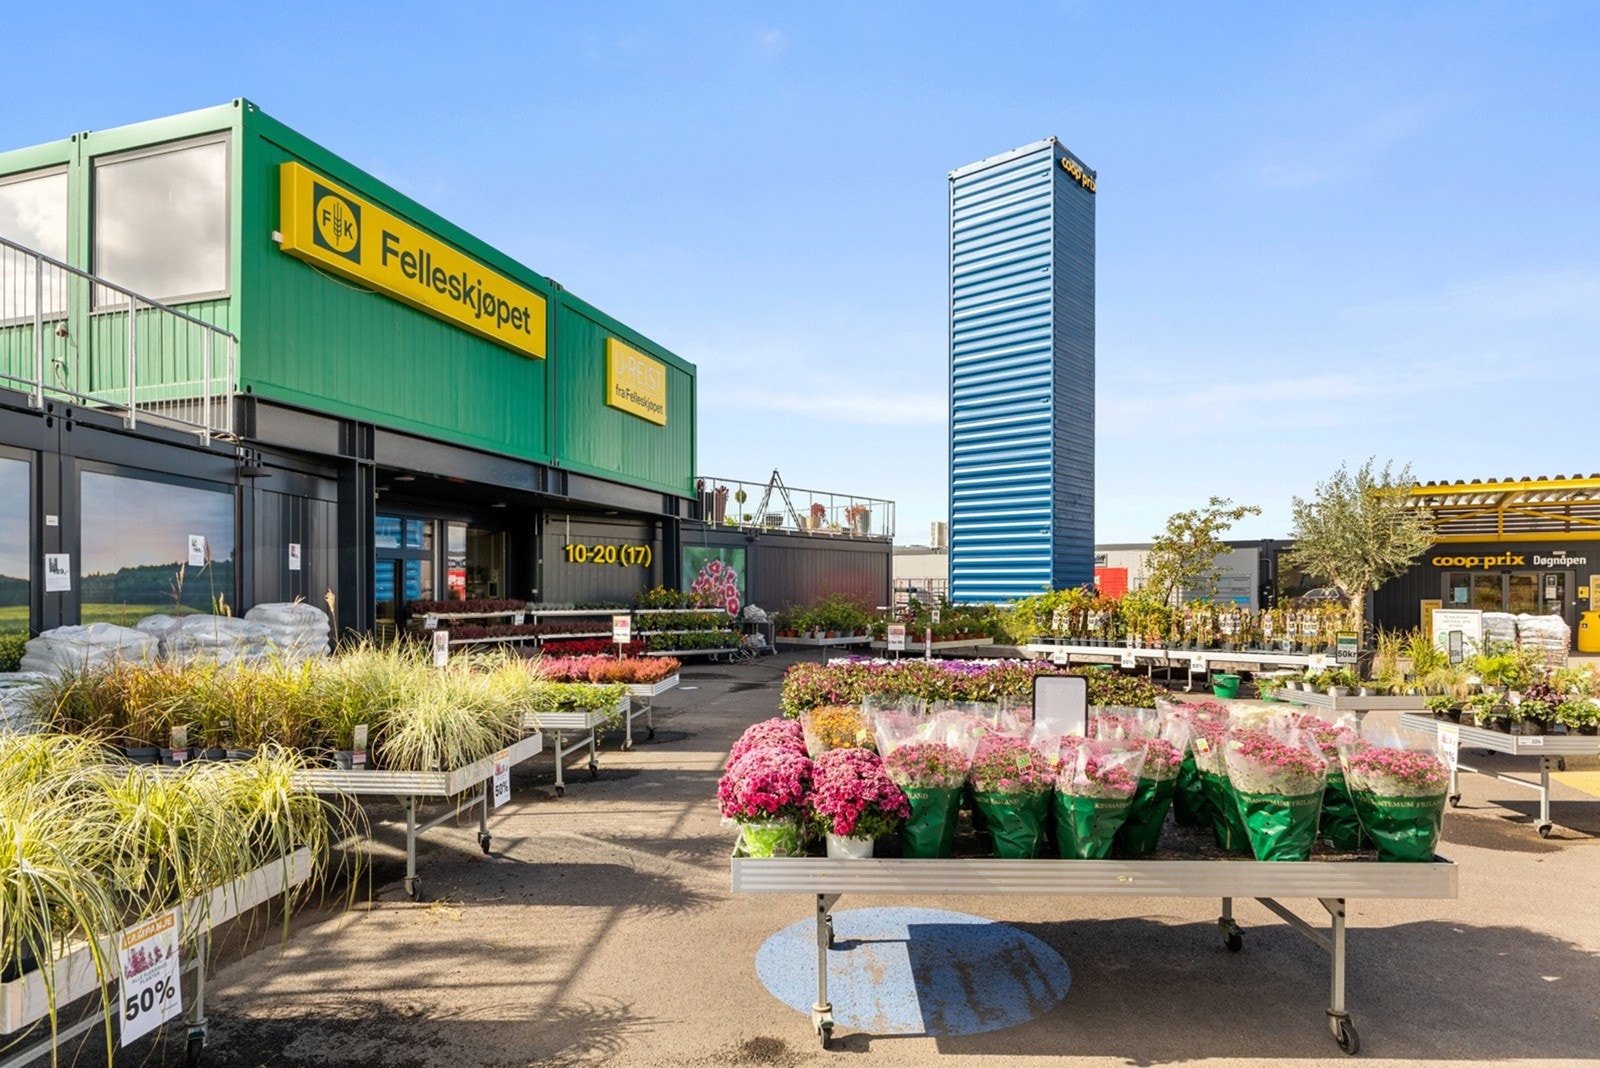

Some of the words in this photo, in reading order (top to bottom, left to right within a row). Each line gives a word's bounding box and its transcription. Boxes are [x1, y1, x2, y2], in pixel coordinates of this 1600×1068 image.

[1061, 157, 1081, 180] coop
[381, 229, 531, 336] Felleskjøpet
[565, 543, 616, 564] 10-20
[620, 543, 652, 568] (17)
[1432, 556, 1479, 568] coop
[1484, 552, 1525, 569] prix
[1533, 555, 1587, 568] Døgnåpen
[495, 780, 509, 797] 50%
[124, 916, 173, 947] KAMPANJE
[126, 975, 176, 1021] 50%
